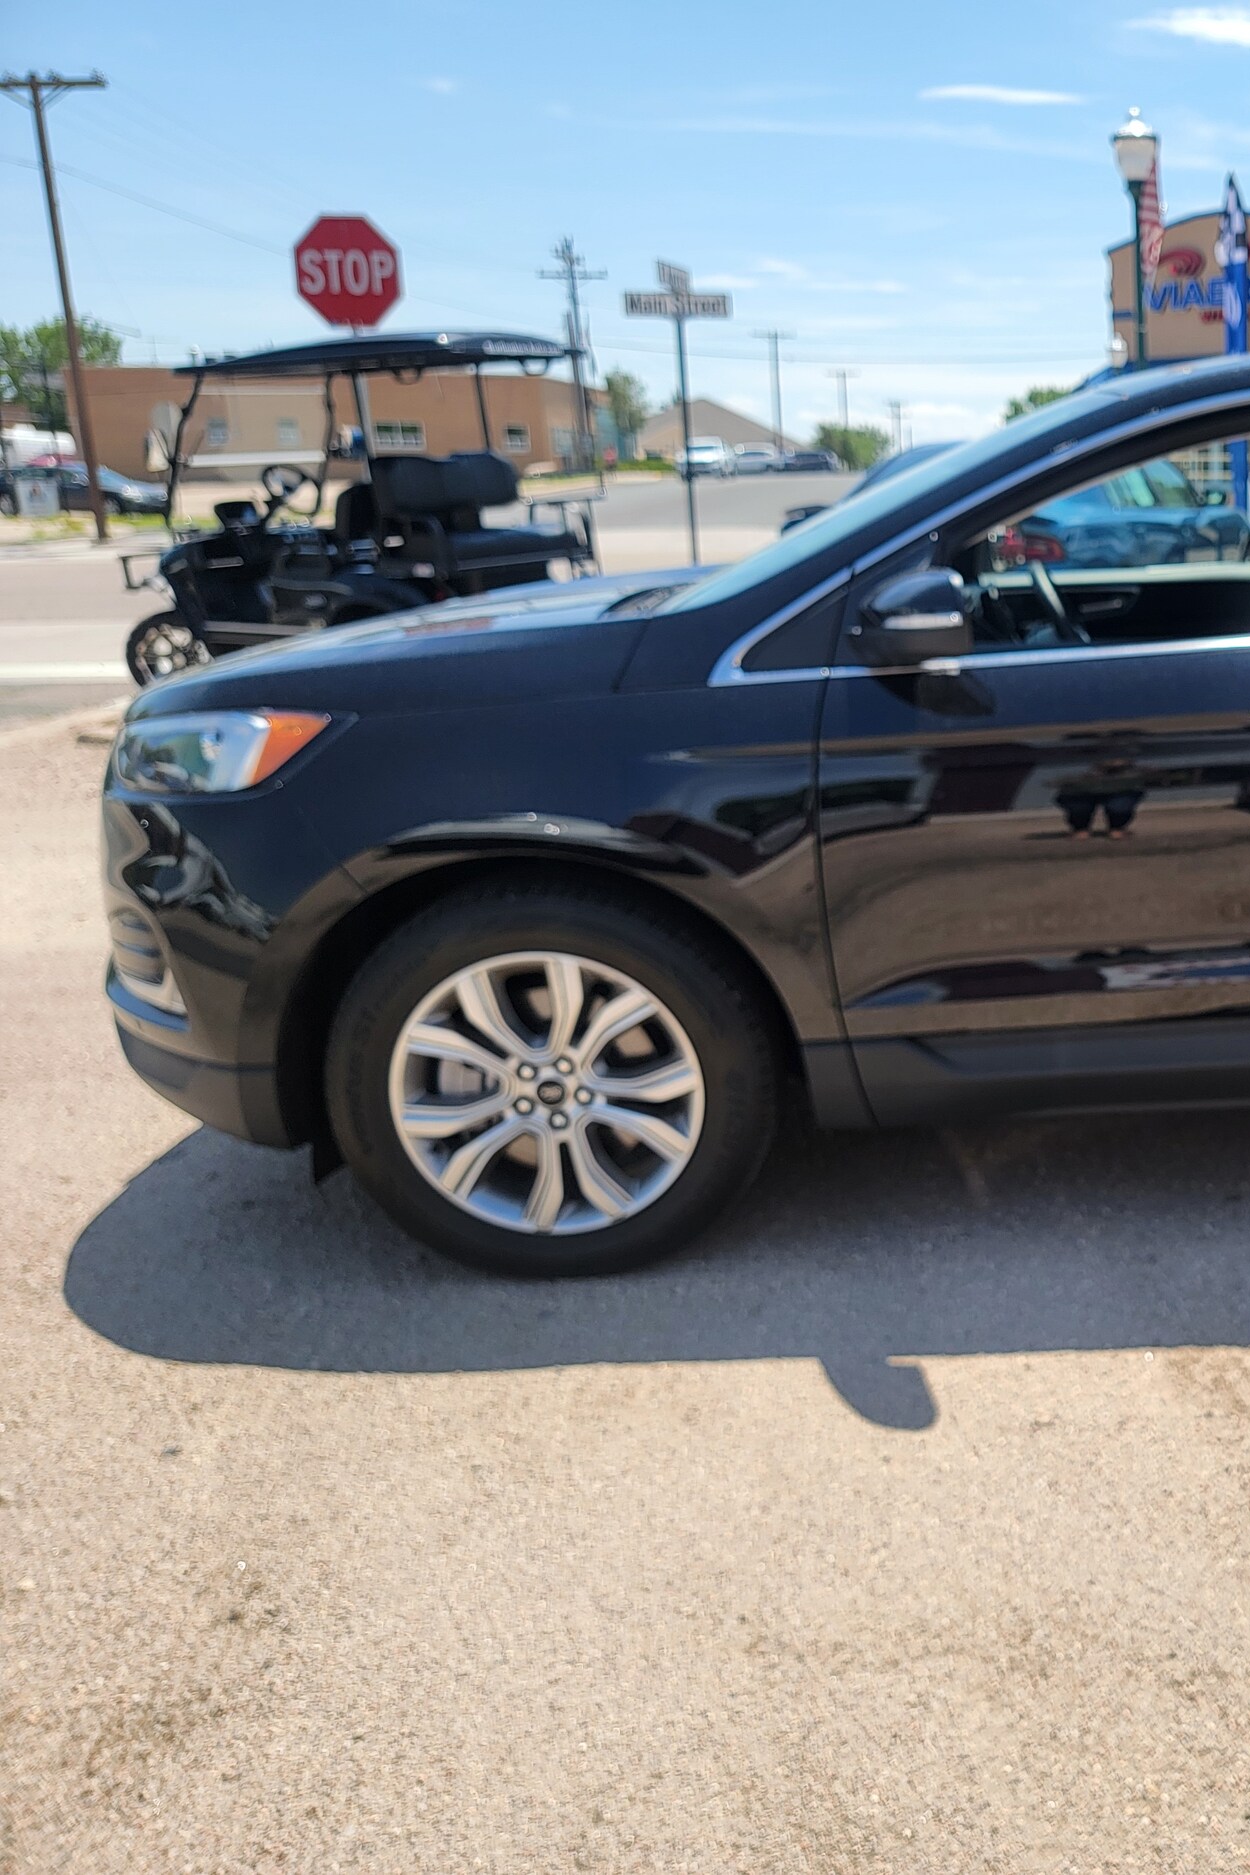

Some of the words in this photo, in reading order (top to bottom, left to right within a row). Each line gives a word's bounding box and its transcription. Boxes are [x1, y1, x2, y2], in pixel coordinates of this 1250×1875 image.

[300, 248, 395, 296] STOP
[629, 294, 667, 315] Main
[671, 294, 726, 315] Street
